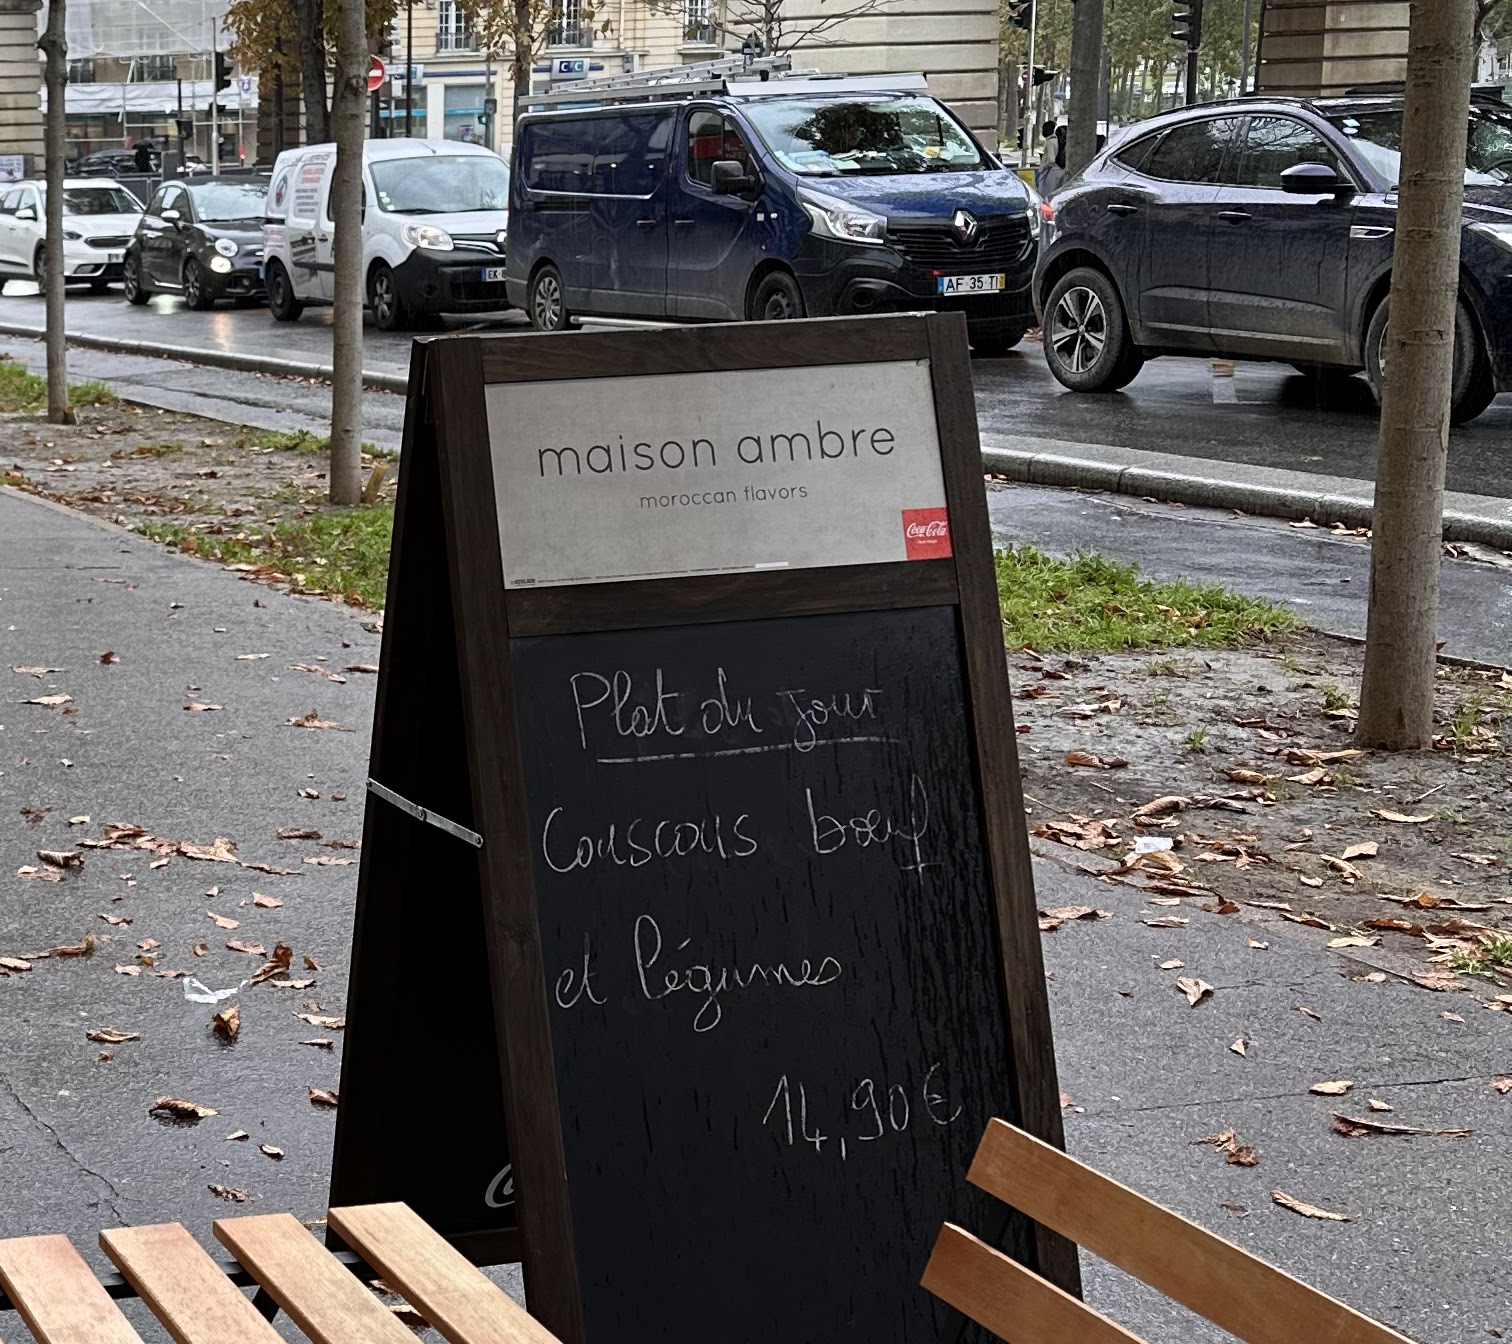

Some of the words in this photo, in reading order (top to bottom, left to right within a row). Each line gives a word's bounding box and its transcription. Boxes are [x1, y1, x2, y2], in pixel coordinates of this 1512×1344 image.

[538, 434, 717, 477] maison
[737, 419, 896, 464] ambre
[639, 490, 737, 509] moroccan
[743, 485, 809, 503] flavors
[570, 667, 686, 750] Plat
[700, 666, 763, 734] du
[555, 946, 608, 1009] et
